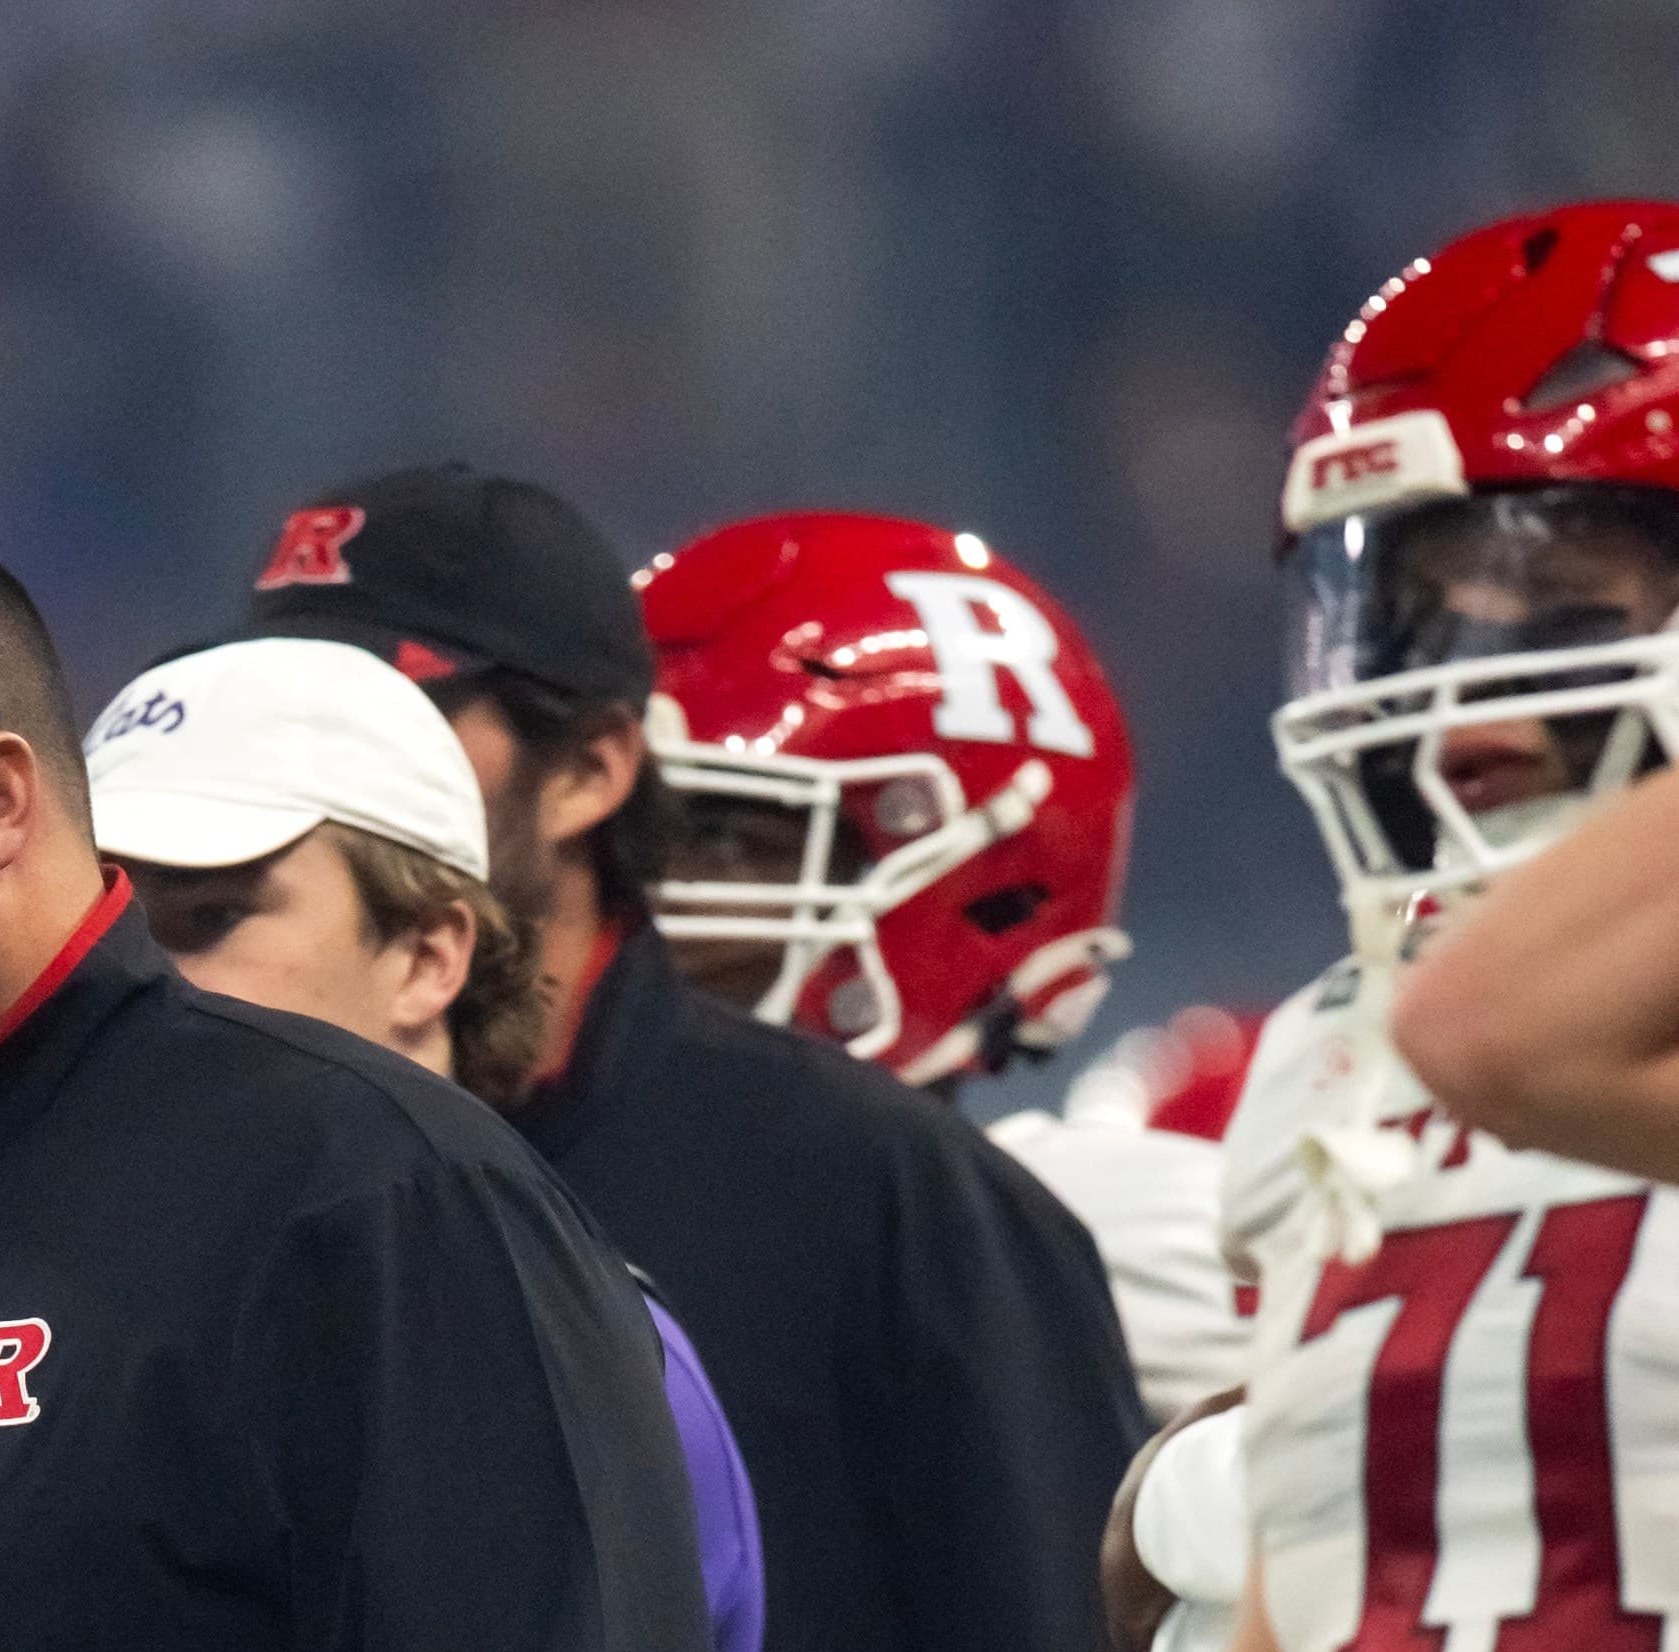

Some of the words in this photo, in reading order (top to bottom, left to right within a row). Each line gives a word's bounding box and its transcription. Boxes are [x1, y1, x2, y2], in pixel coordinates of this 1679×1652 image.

[254, 506, 367, 590] R
[883, 569, 1095, 758] R
[86, 691, 185, 757] ats
